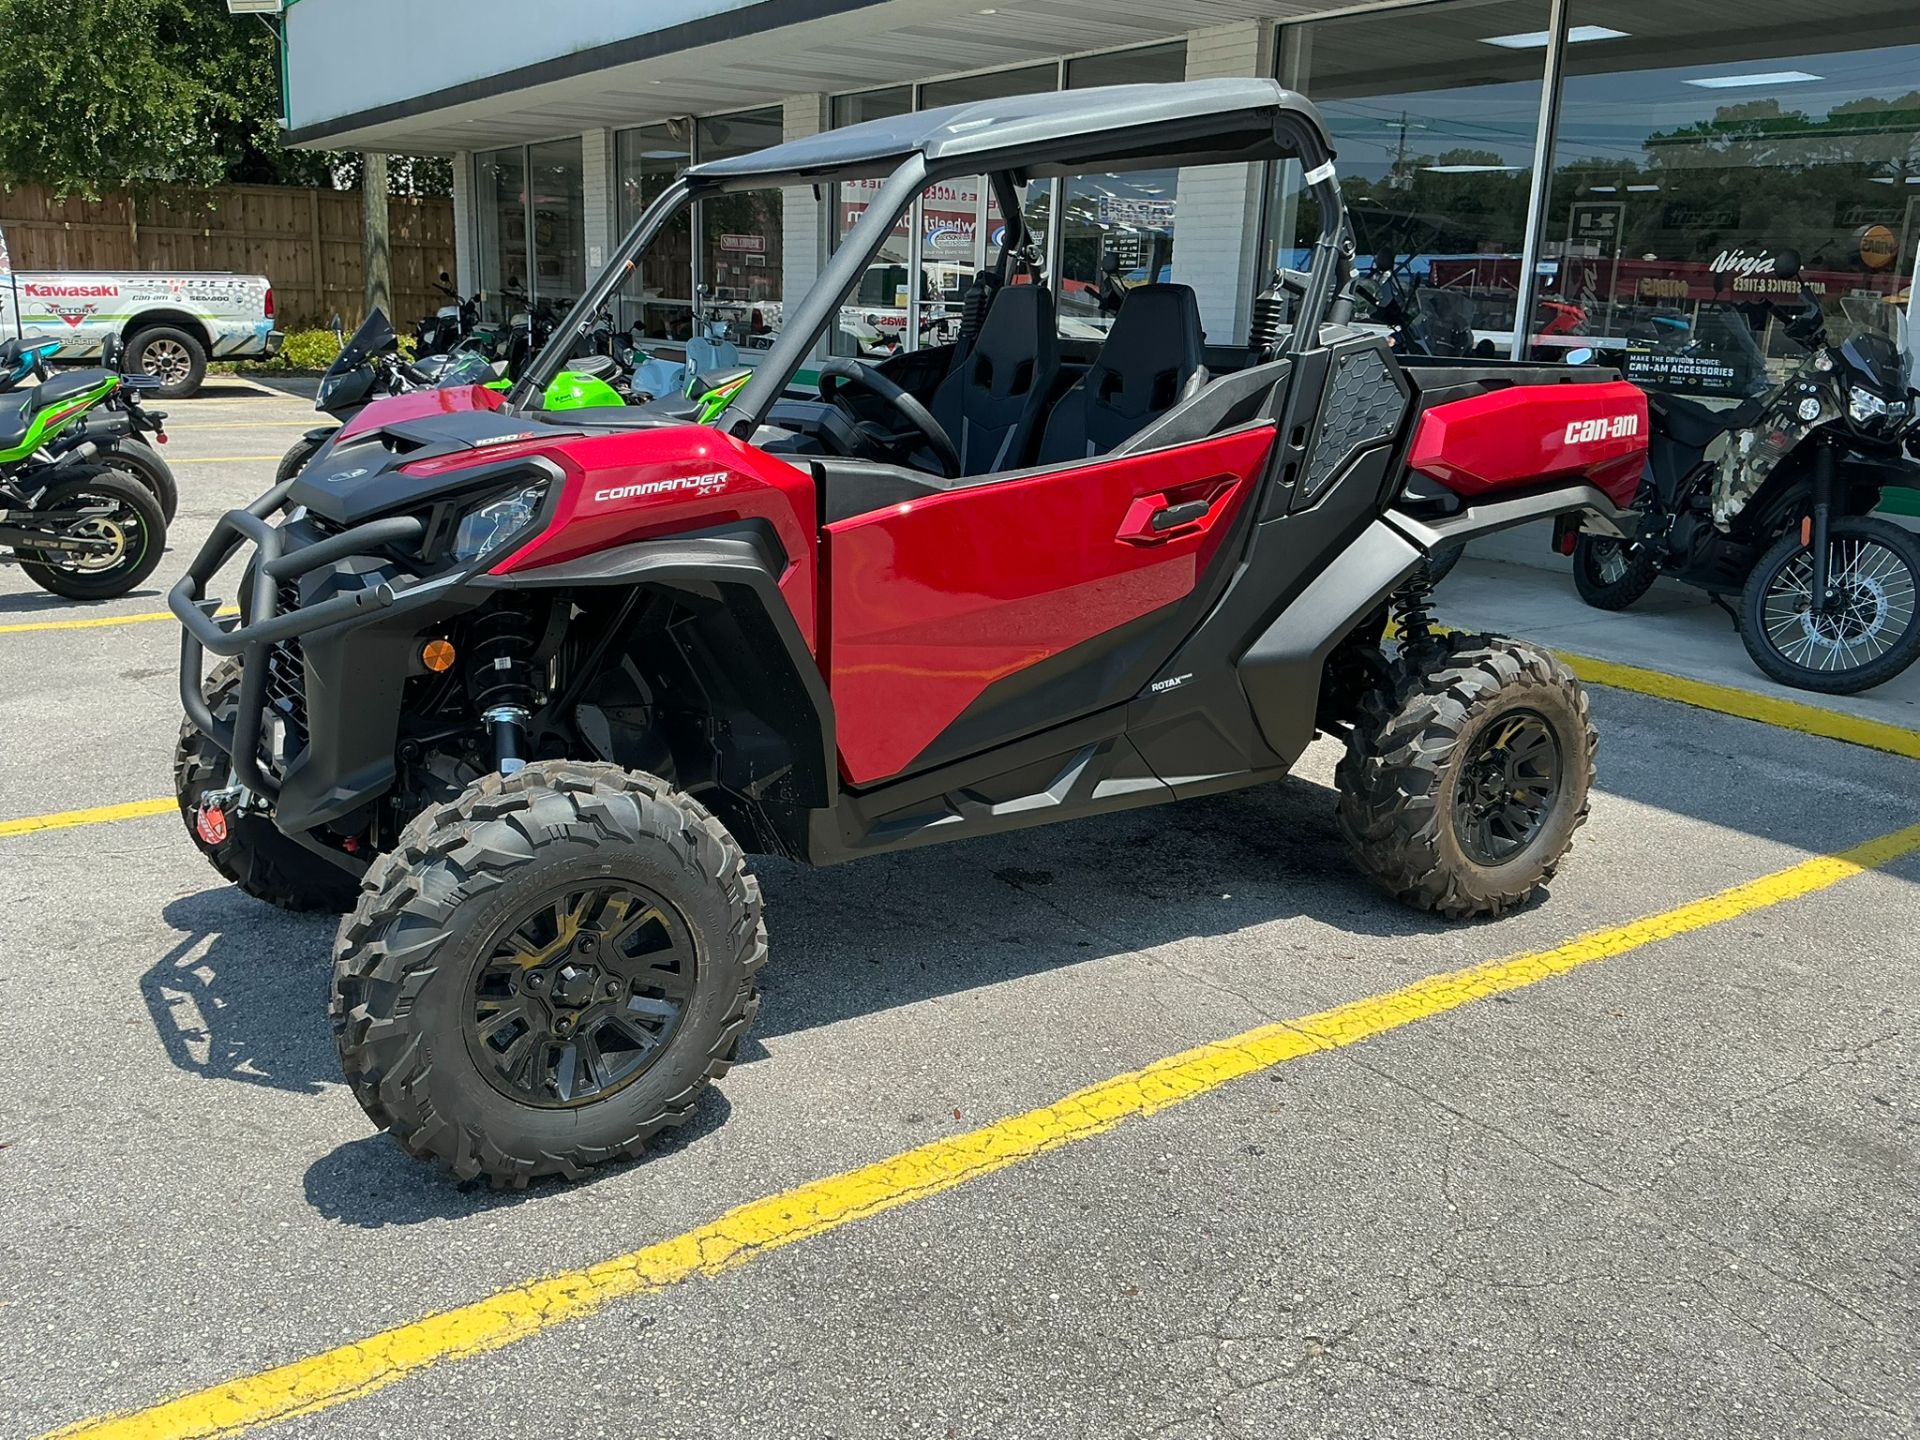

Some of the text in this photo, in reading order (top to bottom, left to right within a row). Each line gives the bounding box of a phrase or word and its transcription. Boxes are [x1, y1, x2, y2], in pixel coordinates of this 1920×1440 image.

[1709, 249, 1776, 278] Ninja
[24, 283, 119, 297] Kawasaki
[45, 307, 100, 315] VICTORY
[59, 337, 101, 346] OLARIS
[1630, 355, 1649, 363] MAKE
[1665, 357, 1694, 365] OBVIOUS
[1629, 362, 1735, 377] CAN-AM ACCESSORIES
[1564, 414, 1638, 445] can-am
[594, 472, 728, 502] COMMANDER
[696, 483, 726, 496] XT
[1151, 676, 1182, 692] ROTAX
